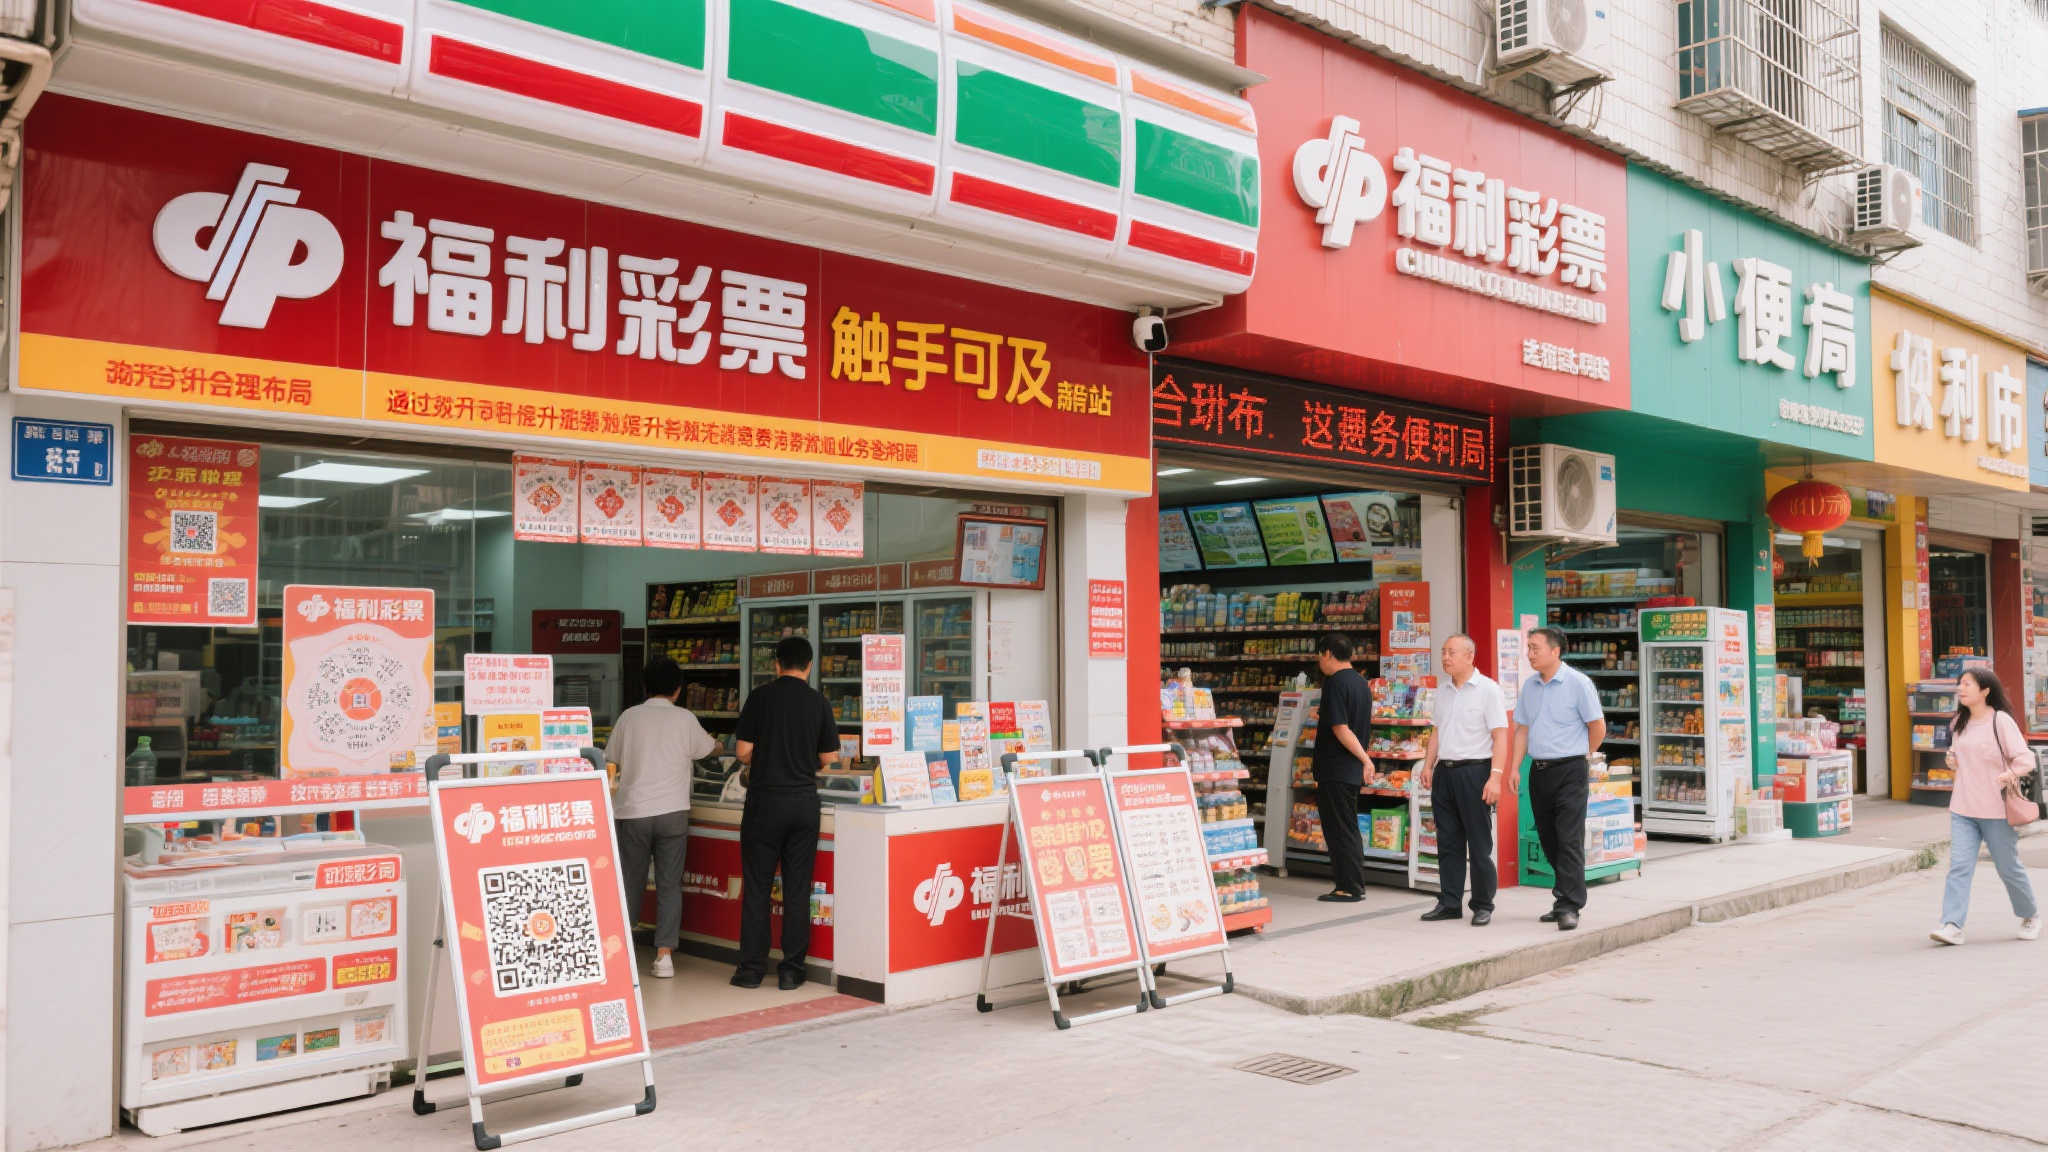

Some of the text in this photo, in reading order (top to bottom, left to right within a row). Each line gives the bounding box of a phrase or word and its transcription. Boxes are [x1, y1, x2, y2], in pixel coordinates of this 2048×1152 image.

[1392, 146, 1607, 293] 福利彩票
[379, 210, 807, 381] 福利彩票
[830, 305, 1054, 409] 触手可及
[334, 597, 425, 622] 福利彩票
[499, 800, 595, 833] 福利彩票
